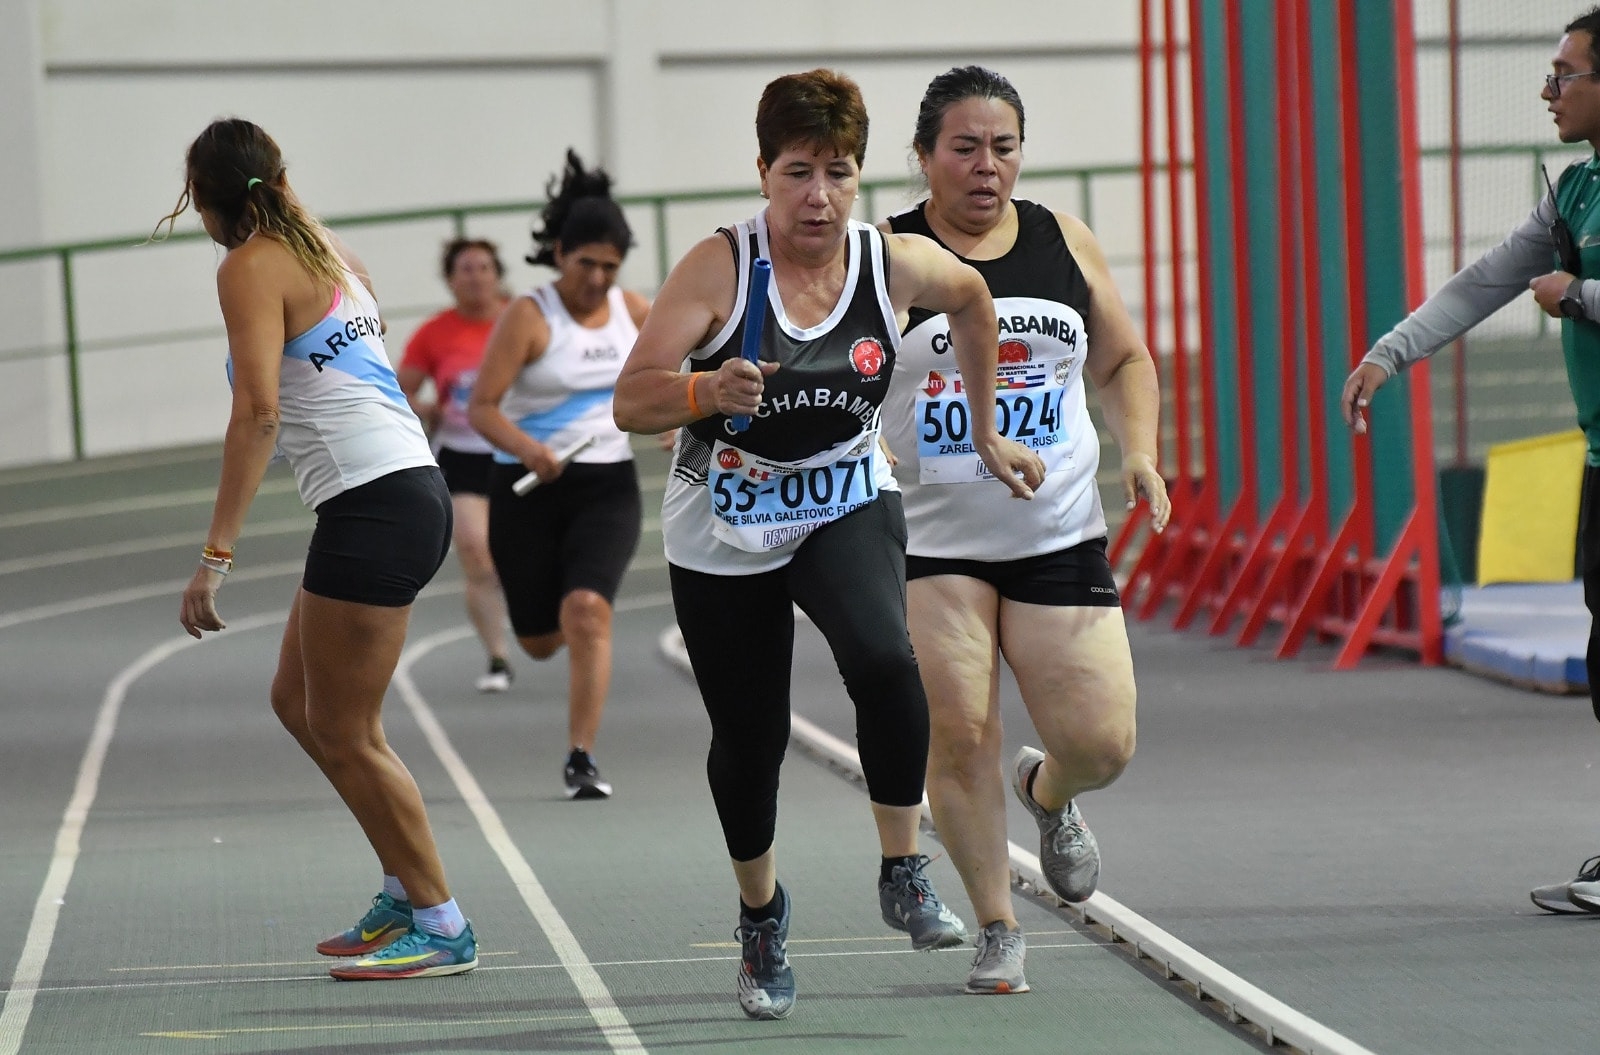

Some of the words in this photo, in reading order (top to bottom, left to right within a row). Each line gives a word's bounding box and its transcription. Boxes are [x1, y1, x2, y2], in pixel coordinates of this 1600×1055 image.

[931, 315, 1077, 355] CABAMBA
[928, 379, 943, 389] NTI
[724, 388, 874, 436] CCHABAMBA
[720, 453, 741, 466] INTI
[714, 456, 874, 513] 55-0071
[741, 512, 772, 525] SILVIA
[774, 506, 835, 523] GALETOVIC
